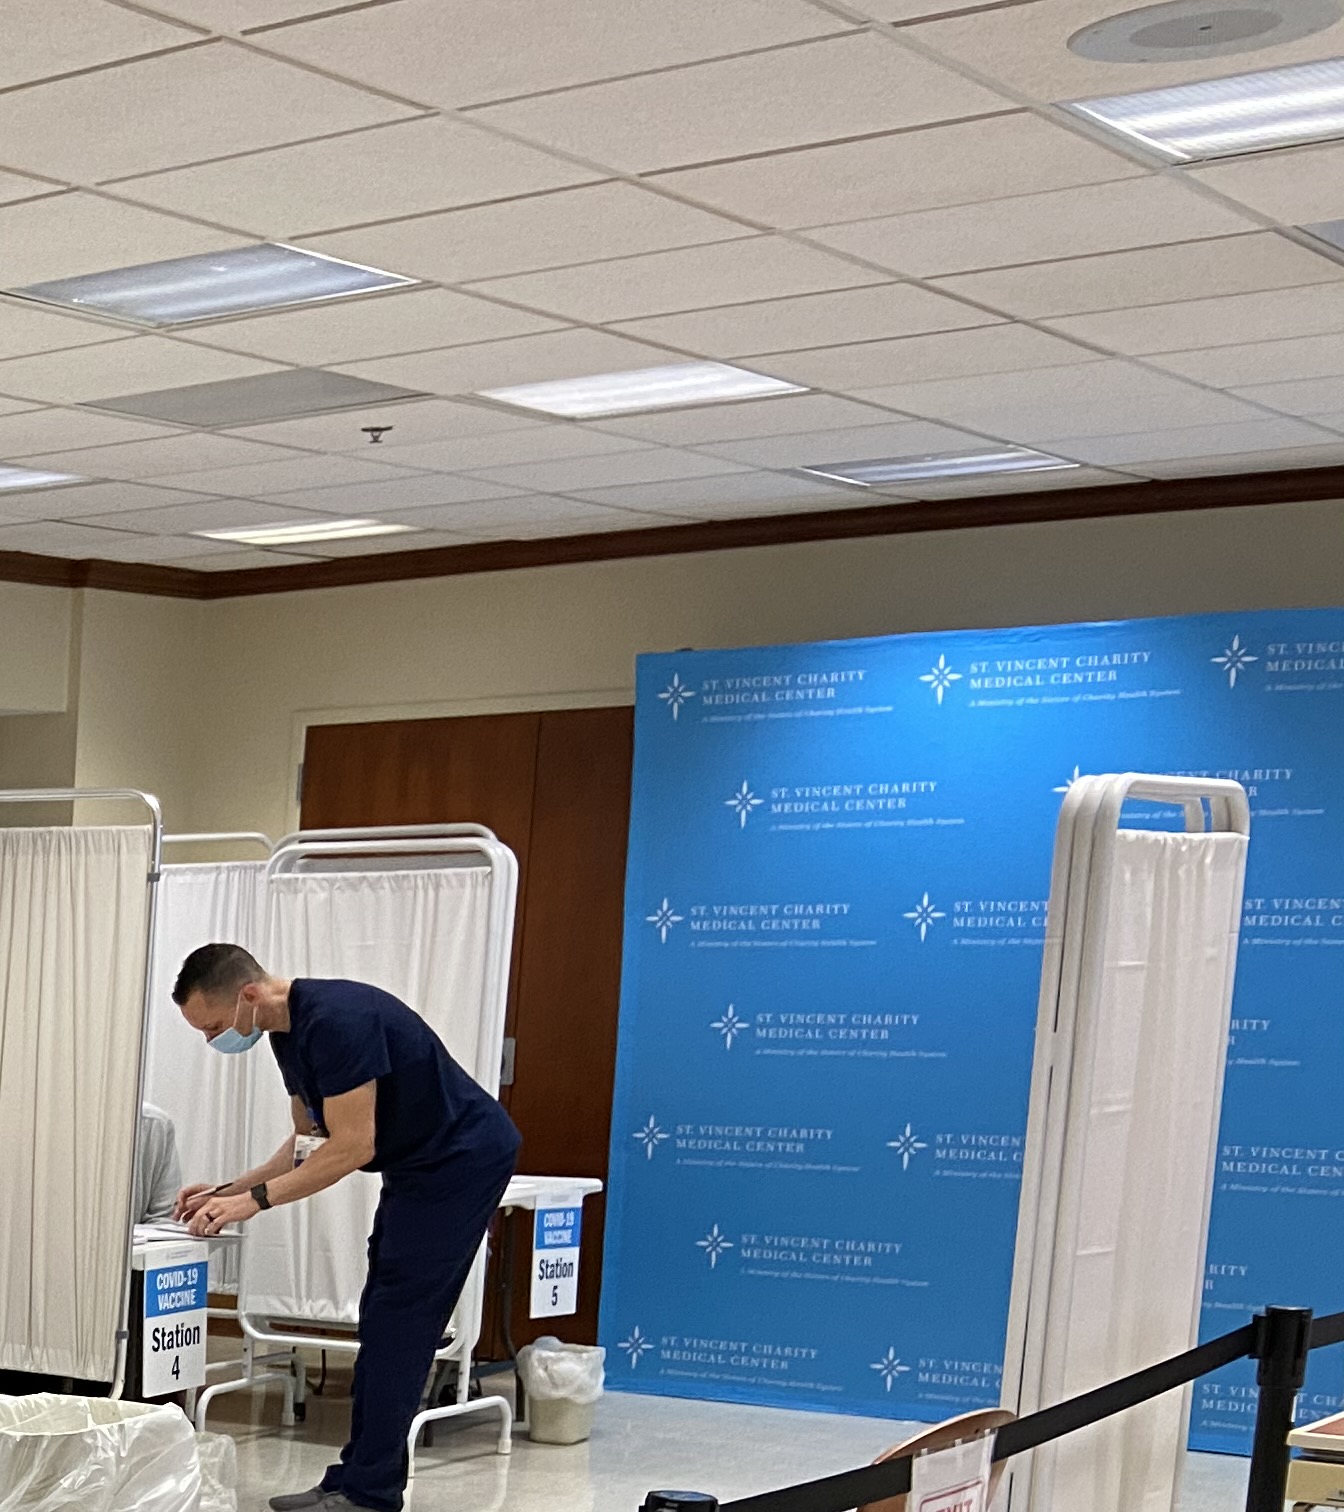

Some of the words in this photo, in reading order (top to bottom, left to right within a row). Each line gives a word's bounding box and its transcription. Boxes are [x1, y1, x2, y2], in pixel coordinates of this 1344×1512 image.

[1296, 641, 1344, 655] VINC
[996, 657, 1070, 672] VINCENT
[1075, 651, 1152, 668] CHARITY
[969, 673, 1045, 689] MEDICAL
[1050, 669, 1117, 685] CENTER
[795, 785, 863, 797] VINCENT
[868, 781, 938, 795] CHARITY
[771, 801, 840, 814] MEDICAL
[845, 798, 907, 811] CENTER
[713, 905, 779, 915] VINCENT
[783, 904, 850, 915] CHARITY
[1272, 898, 1344, 910] VINCEN
[690, 920, 755, 931] MEDICAL
[761, 919, 821, 930] CENTER
[953, 916, 1026, 928] MEDICAL
[1243, 915, 1324, 926] MEDICAL
[779, 1013, 847, 1025] VINCENT
[851, 1014, 919, 1026] CHARITY
[1231, 1019, 1271, 1031] RITY
[755, 1028, 824, 1039] MEDICAL
[828, 1028, 889, 1040] CENTER
[698, 1125, 763, 1138] VINCENT
[767, 1127, 833, 1140] CHARITY
[676, 1139, 741, 1151] MEDICAL
[745, 1141, 804, 1153] CENTER
[961, 1134, 1021, 1147] VINCEN
[935, 1148, 1007, 1161] MEDICAL
[1250, 1146, 1329, 1160] VINCENT
[1221, 1161, 1302, 1176] MEDICAL
[1308, 1165, 1344, 1177] CEN
[764, 1235, 829, 1249] VINCENT
[835, 1240, 903, 1254] CHARITY
[740, 1249, 807, 1262] MEDICAL
[812, 1253, 872, 1266] CENTER
[538, 1257, 574, 1280] Station
[1209, 1264, 1248, 1276] RITY
[156, 1267, 198, 1290] COVID-19
[157, 1289, 197, 1311] VACCINE
[551, 1285, 558, 1306] 5
[152, 1322, 200, 1352] Station
[683, 1337, 748, 1352] VINCENT
[752, 1343, 818, 1359] CHARITY
[660, 1349, 726, 1363] MEDICAL
[730, 1355, 789, 1370] CENTER
[943, 1359, 1002, 1374] VINCEN
[171, 1355, 180, 1380] 4
[917, 1371, 990, 1387] MEDICAL
[1201, 1399, 1256, 1413] MEDIC
